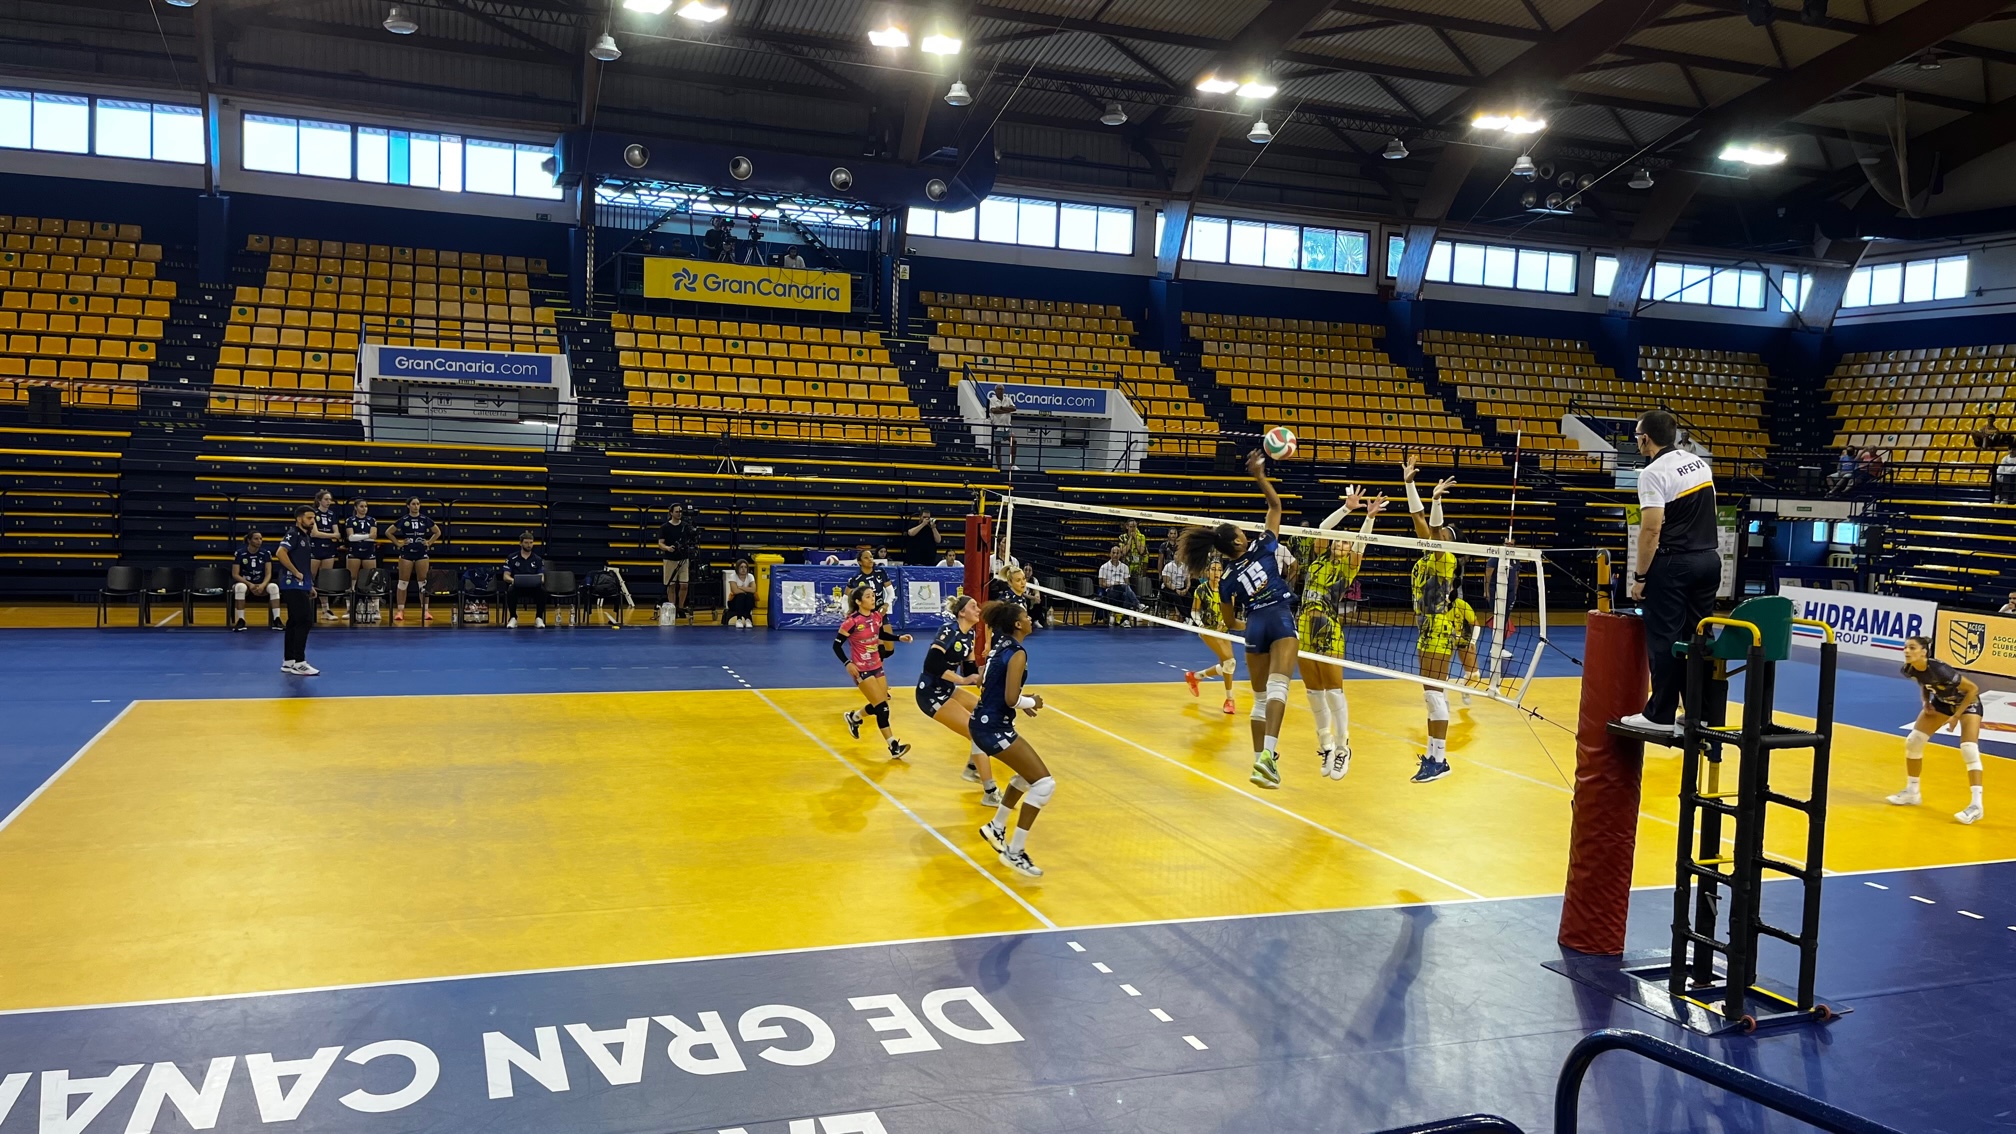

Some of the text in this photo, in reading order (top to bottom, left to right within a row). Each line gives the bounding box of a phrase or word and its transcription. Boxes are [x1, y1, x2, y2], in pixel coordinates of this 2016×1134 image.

[200, 282, 220, 290] FILA
[703, 273, 840, 301] GranCanaria
[394, 356, 538, 376] GranCanaria.com
[148, 409, 172, 417] FILA
[411, 521, 419, 529] 13
[1356, 534, 1378, 542] rfevb.com
[1416, 540, 1442, 549] rfevb.com
[1236, 561, 1268, 596] 15
[1803, 601, 1923, 639] HIDRAMAR
[1832, 631, 1868, 645] ROUP
[847, 986, 1026, 1055] DE
[482, 1004, 836, 1100] GRAN
